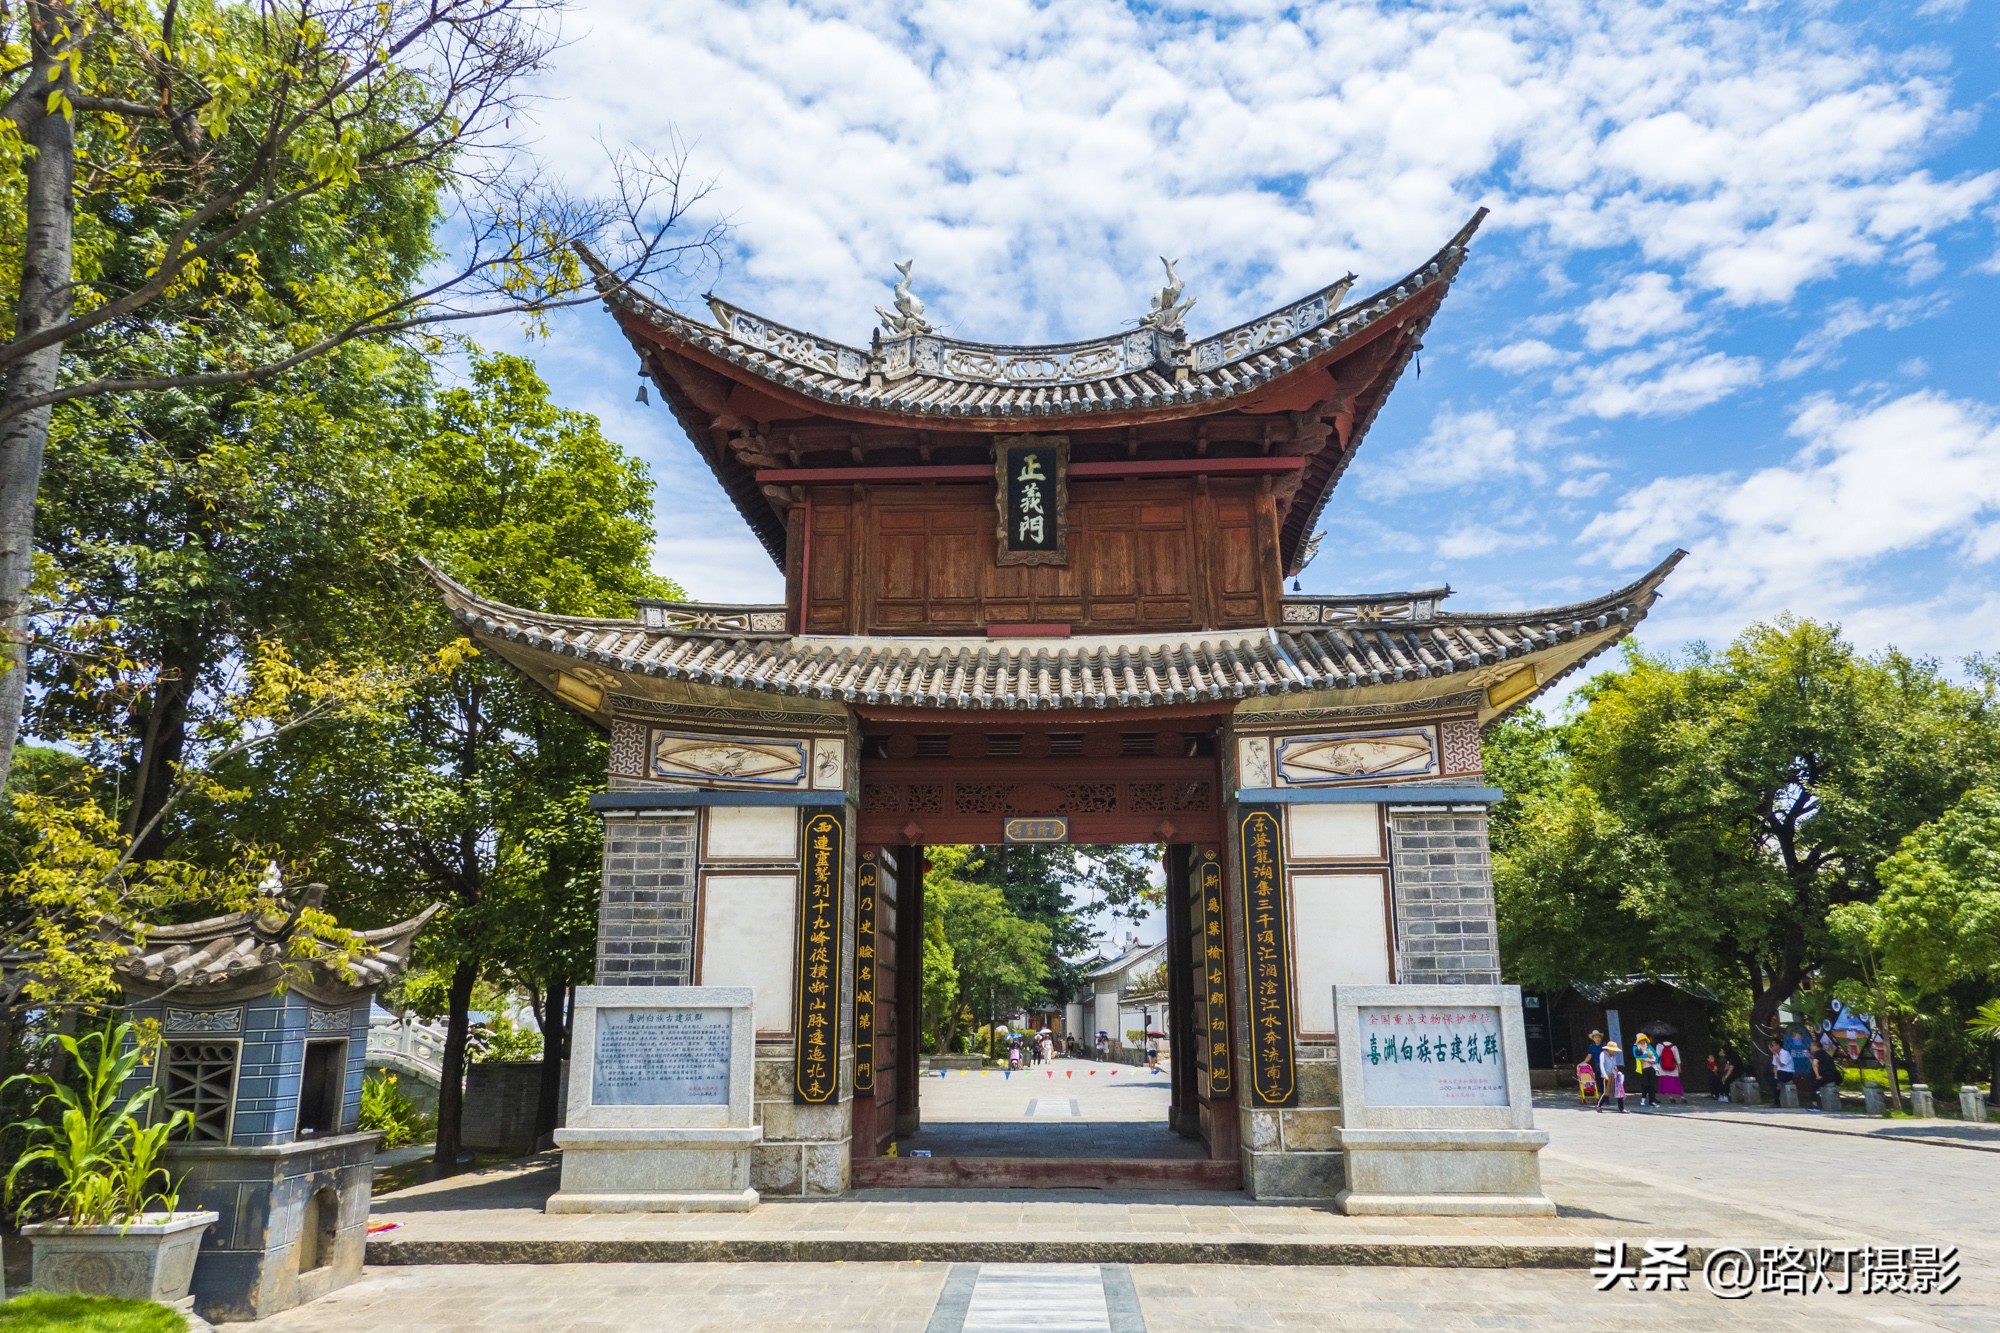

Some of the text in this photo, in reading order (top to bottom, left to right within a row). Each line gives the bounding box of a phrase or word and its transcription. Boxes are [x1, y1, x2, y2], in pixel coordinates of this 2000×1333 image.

[1017, 454, 1046, 544] 正義門
[627, 1013, 703, 1023] 喜洲白族古建筑群
[1368, 1013, 1492, 1026] 全国重点文物保护单位
[1367, 1032, 1498, 1066] 喜洲白族古建筑群
